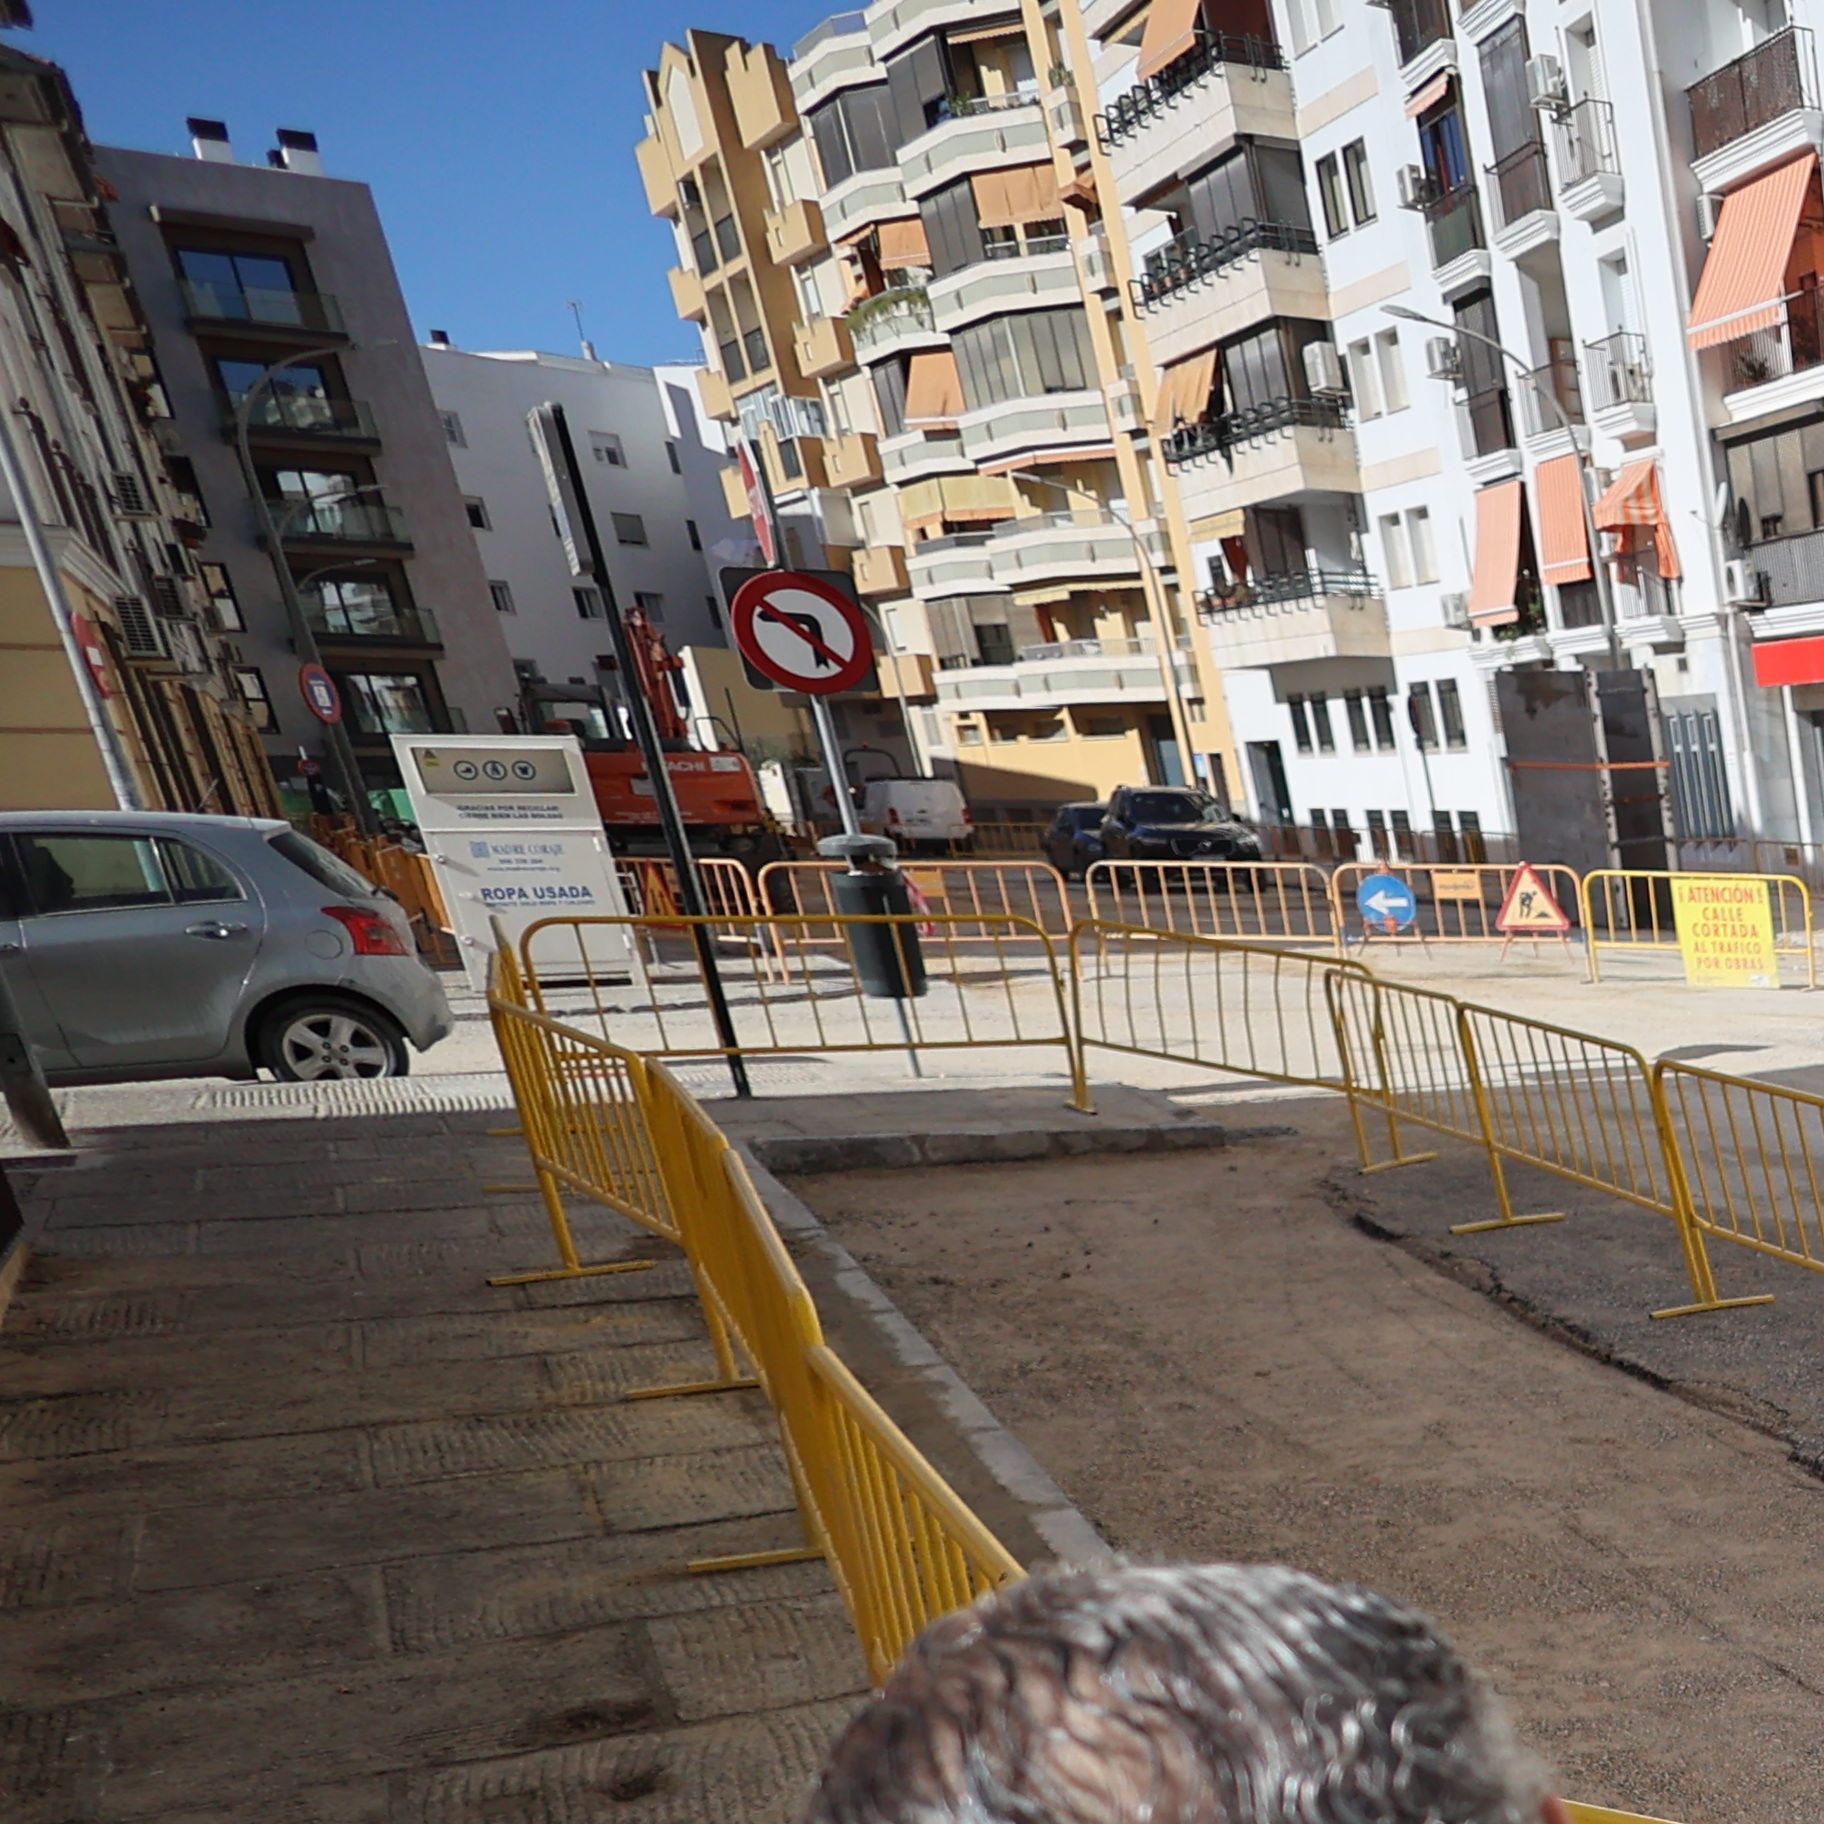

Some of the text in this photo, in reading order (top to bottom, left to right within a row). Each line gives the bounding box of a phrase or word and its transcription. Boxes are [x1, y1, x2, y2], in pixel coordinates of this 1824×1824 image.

[480, 884, 593, 901] ROPA USADA
[1702, 906, 1744, 922] CALLE
[1691, 922, 1760, 938] CORTADA
[1693, 941, 1706, 954] AL
[1695, 957, 1764, 970] POR OBRAS
